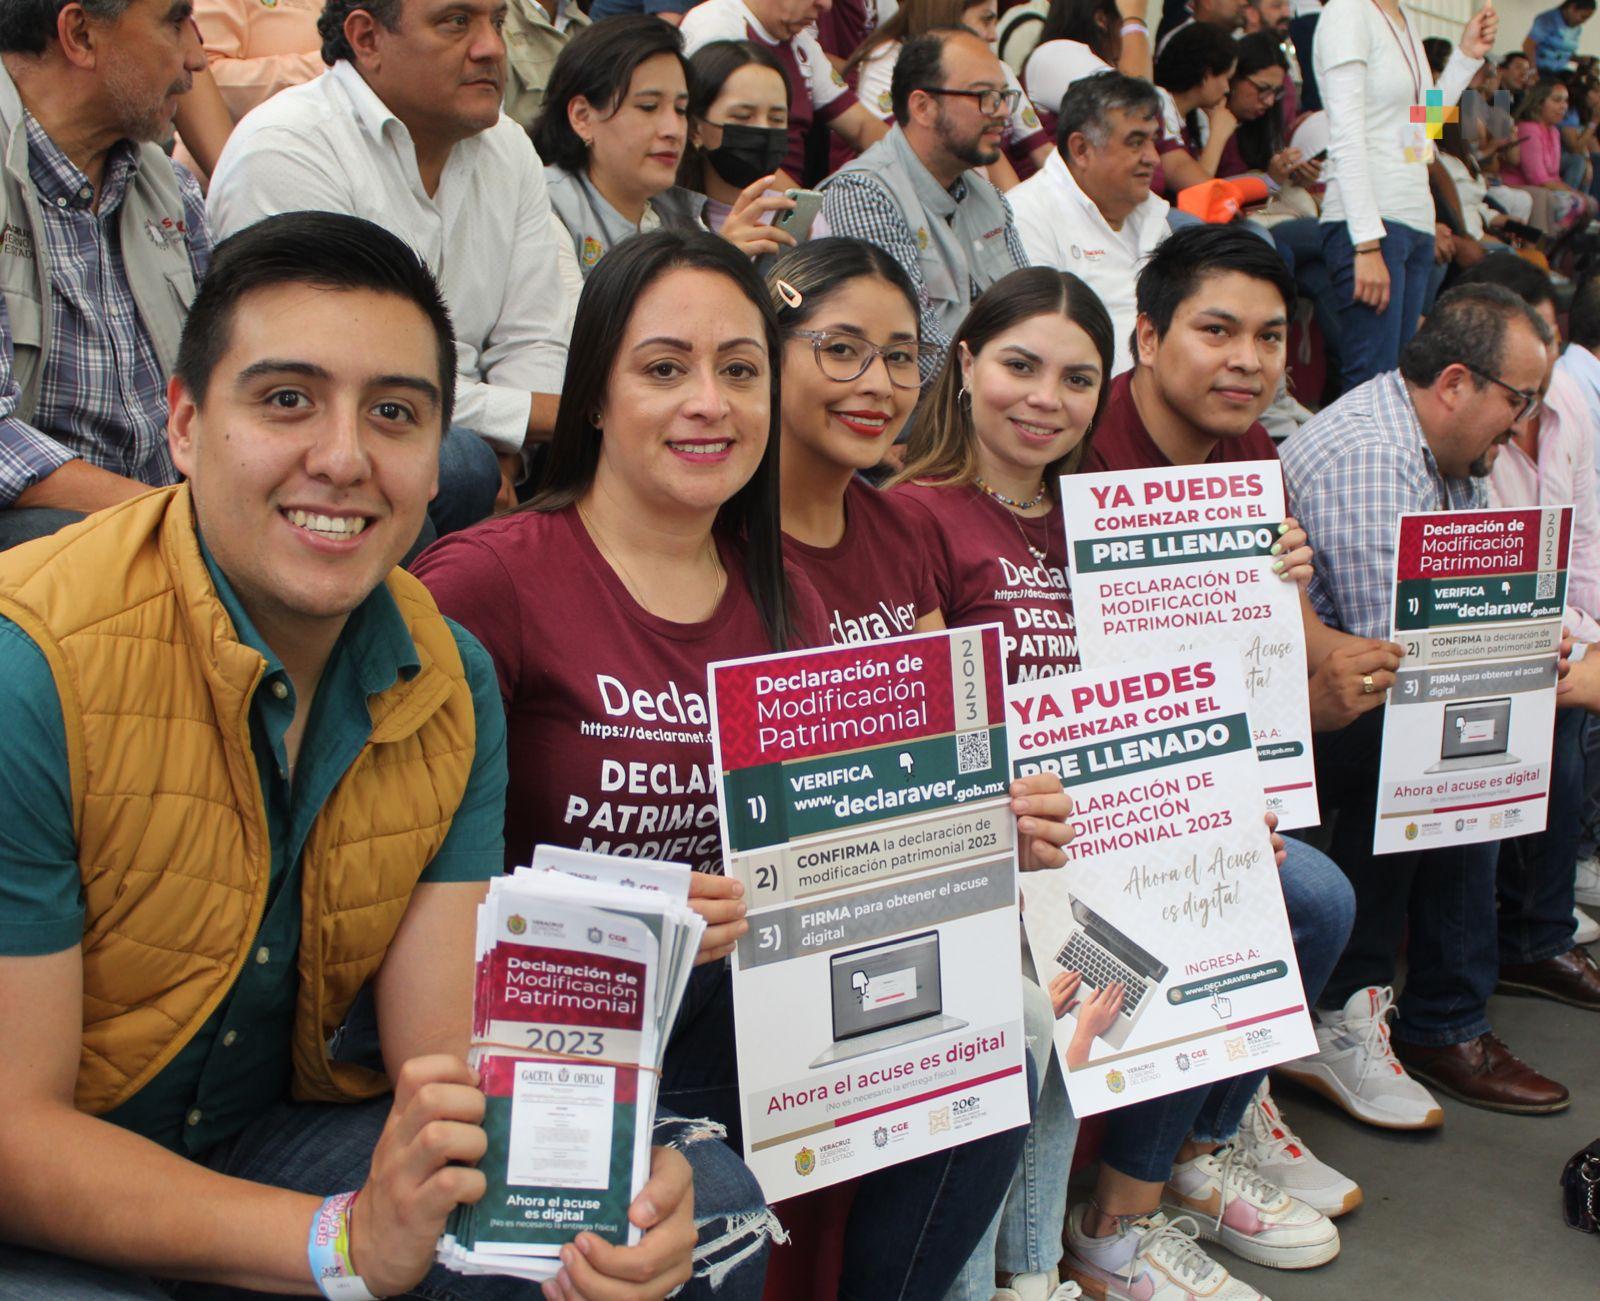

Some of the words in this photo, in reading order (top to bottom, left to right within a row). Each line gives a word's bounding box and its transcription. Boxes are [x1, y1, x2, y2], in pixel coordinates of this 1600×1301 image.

[1090, 484, 1135, 509] YA
[1144, 474, 1263, 504] PUEDES
[1094, 509, 1199, 531] COMENZAR
[1205, 506, 1243, 522] CON
[1247, 504, 1266, 518] EL
[1423, 520, 1504, 536] Declaración
[1507, 519, 1525, 532] de
[1092, 540, 1145, 564] PRE
[1152, 528, 1273, 559] LLENADO
[1422, 534, 1524, 554] Modificación
[1544, 514, 1556, 566] 2023
[1420, 551, 1523, 572] Patrimonial
[1100, 571, 1230, 598] DECLARACIÓN
[1236, 569, 1260, 583] DE
[1434, 586, 1485, 599] VERIFICA
[1101, 588, 1236, 617] MODIFICACIÓN
[1408, 598, 1419, 616] 1)
[1435, 600, 1560, 619] www.declaraver.gob.mx
[1103, 608, 1226, 636] PATRIMONIAL
[1232, 605, 1272, 622] 2023
[1407, 642, 1420, 658] 2)
[1431, 645, 1485, 658] modificación
[1488, 641, 1533, 655] patrimonial
[1535, 639, 1551, 649] 2023
[1432, 636, 1482, 647] CONFIRMA
[1484, 634, 1492, 642] la
[1494, 630, 1538, 643] declaración
[1540, 629, 1550, 638] de
[756, 658, 890, 695] Declaración
[896, 654, 923, 673] de
[961, 639, 978, 720] 2023
[1405, 680, 1419, 696] 3)
[1430, 673, 1461, 684] FIRMA
[1462, 673, 1480, 683] para
[1482, 668, 1513, 680] obtener
[1515, 668, 1522, 677] el
[1523, 666, 1543, 676] acuse
[757, 677, 925, 722] Modificación
[1010, 694, 1063, 725] YA
[1072, 662, 1217, 714] PUEDES
[1429, 686, 1456, 697] digital
[759, 702, 928, 752] Patrimonial
[1019, 712, 1138, 751] COMENZAR
[1144, 701, 1189, 724] CON
[1196, 696, 1220, 712] EL
[1087, 723, 1230, 773] LLENADO
[791, 764, 873, 792] VERIFICA
[1186, 771, 1215, 791] DE
[1394, 784, 1433, 799] Ahora
[1437, 781, 1447, 794] el
[1451, 778, 1487, 792] acuse
[1490, 776, 1502, 787] es
[1506, 769, 1540, 787] digital
[748, 797, 767, 823] 1)
[795, 778, 1004, 818] www.declaraver.gob.mx
[1188, 810, 1233, 834] 2023
[797, 842, 880, 869] CONFIRMA
[884, 838, 895, 851] la
[898, 823, 971, 848] declaración
[975, 818, 991, 831] de
[799, 858, 887, 887] modificación
[891, 841, 965, 869] patrimonial
[968, 834, 997, 851] 2023
[1123, 864, 1181, 900] Ahora
[1208, 846, 1262, 881] Acuse
[755, 864, 778, 890] 2)
[801, 908, 851, 929] FIRMA
[854, 901, 883, 919] para
[887, 889, 937, 909] obtener
[940, 883, 951, 896] el
[953, 876, 988, 893] acuse
[1183, 881, 1240, 928] digital
[759, 925, 782, 951] 3)
[802, 926, 845, 948] digital
[507, 957, 611, 982] Declaración
[615, 972, 638, 985] de
[1185, 951, 1244, 976] INGRESA
[1247, 949, 1261, 960] A:
[506, 970, 638, 999] Modificación
[1185, 966, 1279, 997] www.DECLARAVER.gob.mx
[504, 985, 637, 1014] Patrimonial
[526, 1028, 605, 1056] 2023
[1191, 1049, 1208, 1059] CGE
[522, 1070, 553, 1081] GACETA
[574, 1072, 606, 1085] OFICIAL
[767, 1083, 828, 1115] Ahora
[835, 1075, 851, 1095] el
[858, 1061, 914, 1089] acuse
[921, 1053, 941, 1071] es
[946, 1031, 1005, 1064] digital
[891, 1121, 909, 1133] CGE
[819, 1138, 851, 1152] VERACRUZ
[506, 1194, 545, 1207] Ahora
[548, 1196, 560, 1208] el
[562, 1198, 601, 1210] acuse
[524, 1209, 540, 1219] es
[542, 1208, 584, 1222] digital
